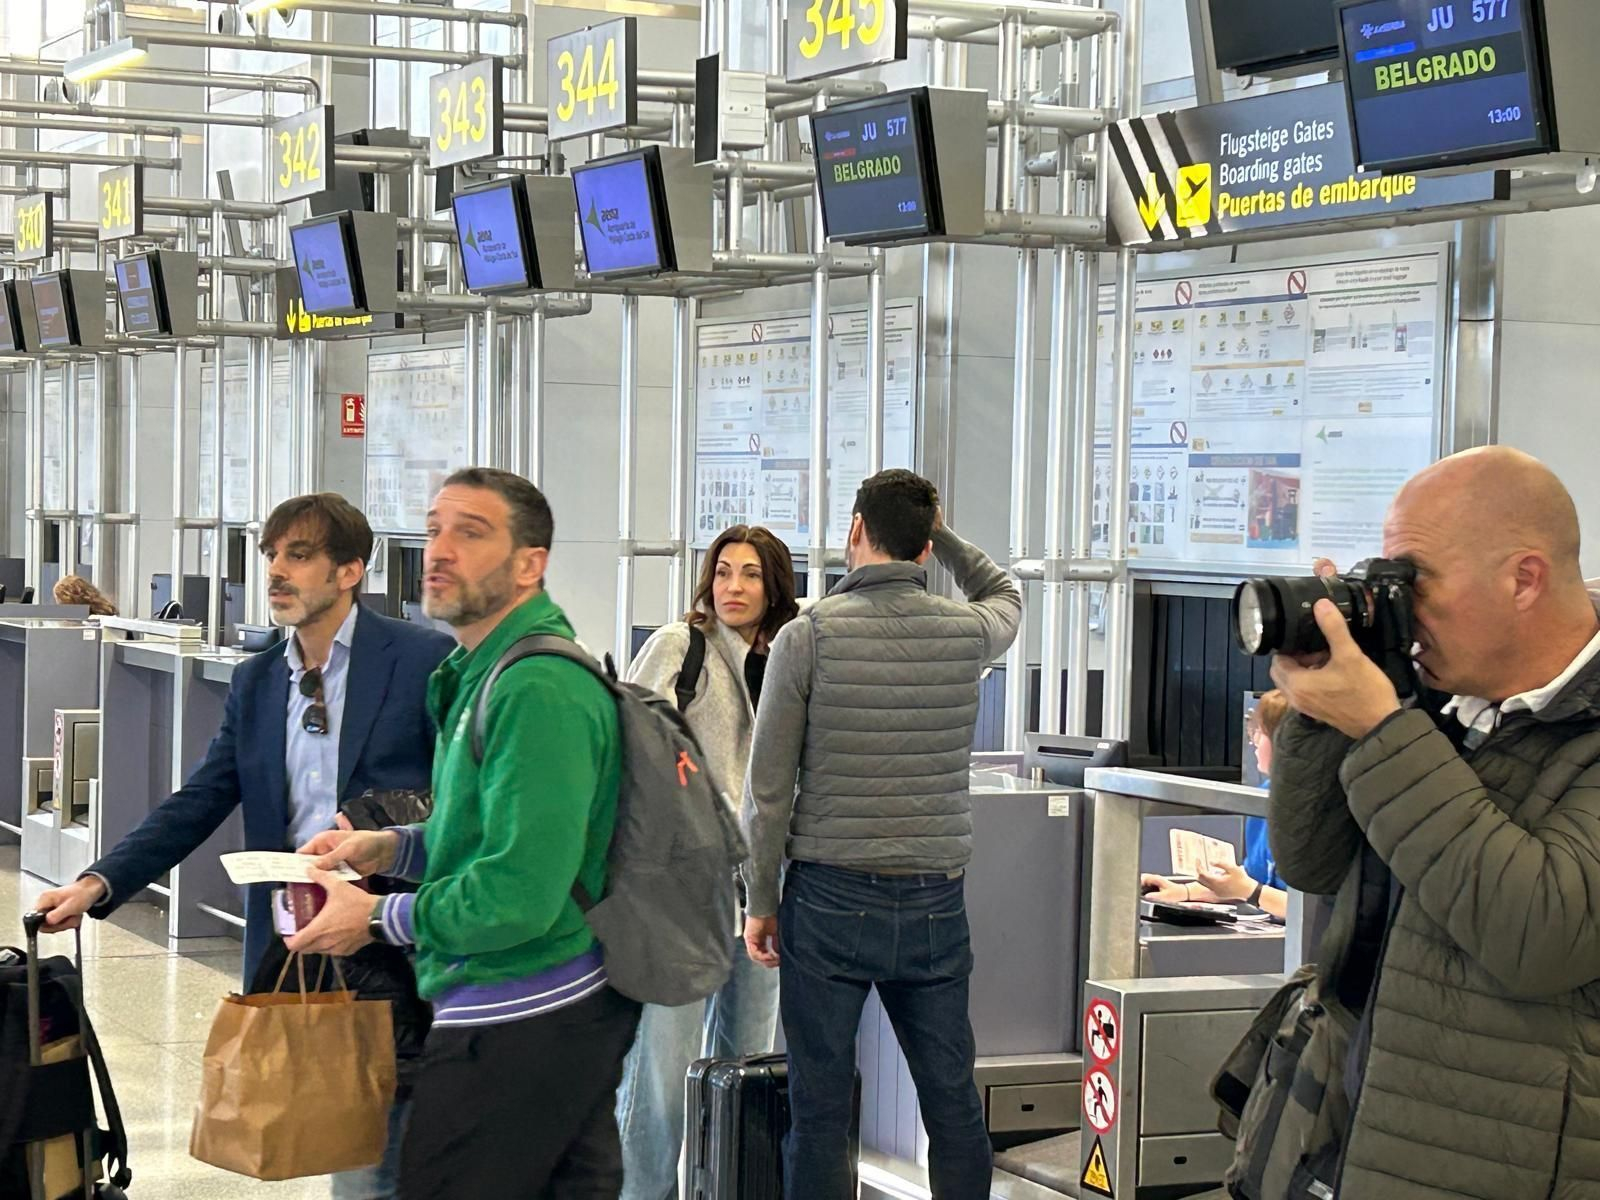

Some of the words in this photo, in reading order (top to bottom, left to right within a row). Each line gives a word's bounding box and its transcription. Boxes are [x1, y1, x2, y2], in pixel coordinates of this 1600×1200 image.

[799, 0, 884, 59] 345
[1427, 5, 1454, 32] JU
[1472, 0, 1508, 23] 577
[557, 38, 618, 121] 344
[1374, 46, 1496, 91] BELGRADO
[436, 76, 486, 152] 343
[862, 122, 877, 142] JU
[886, 116, 907, 137] 577
[1487, 106, 1521, 124] 13:00
[279, 122, 321, 189] 342
[1219, 126, 1288, 157] Flugsteige
[1293, 120, 1334, 144] Gates
[833, 155, 902, 183] BELGRADO
[1219, 158, 1279, 186] Boarding
[1283, 153, 1323, 181] gates
[102, 177, 131, 230] 341
[1217, 191, 1286, 220] Puertas
[1291, 182, 1314, 209] de
[1319, 174, 1416, 204] embarque
[18, 203, 44, 252] 340
